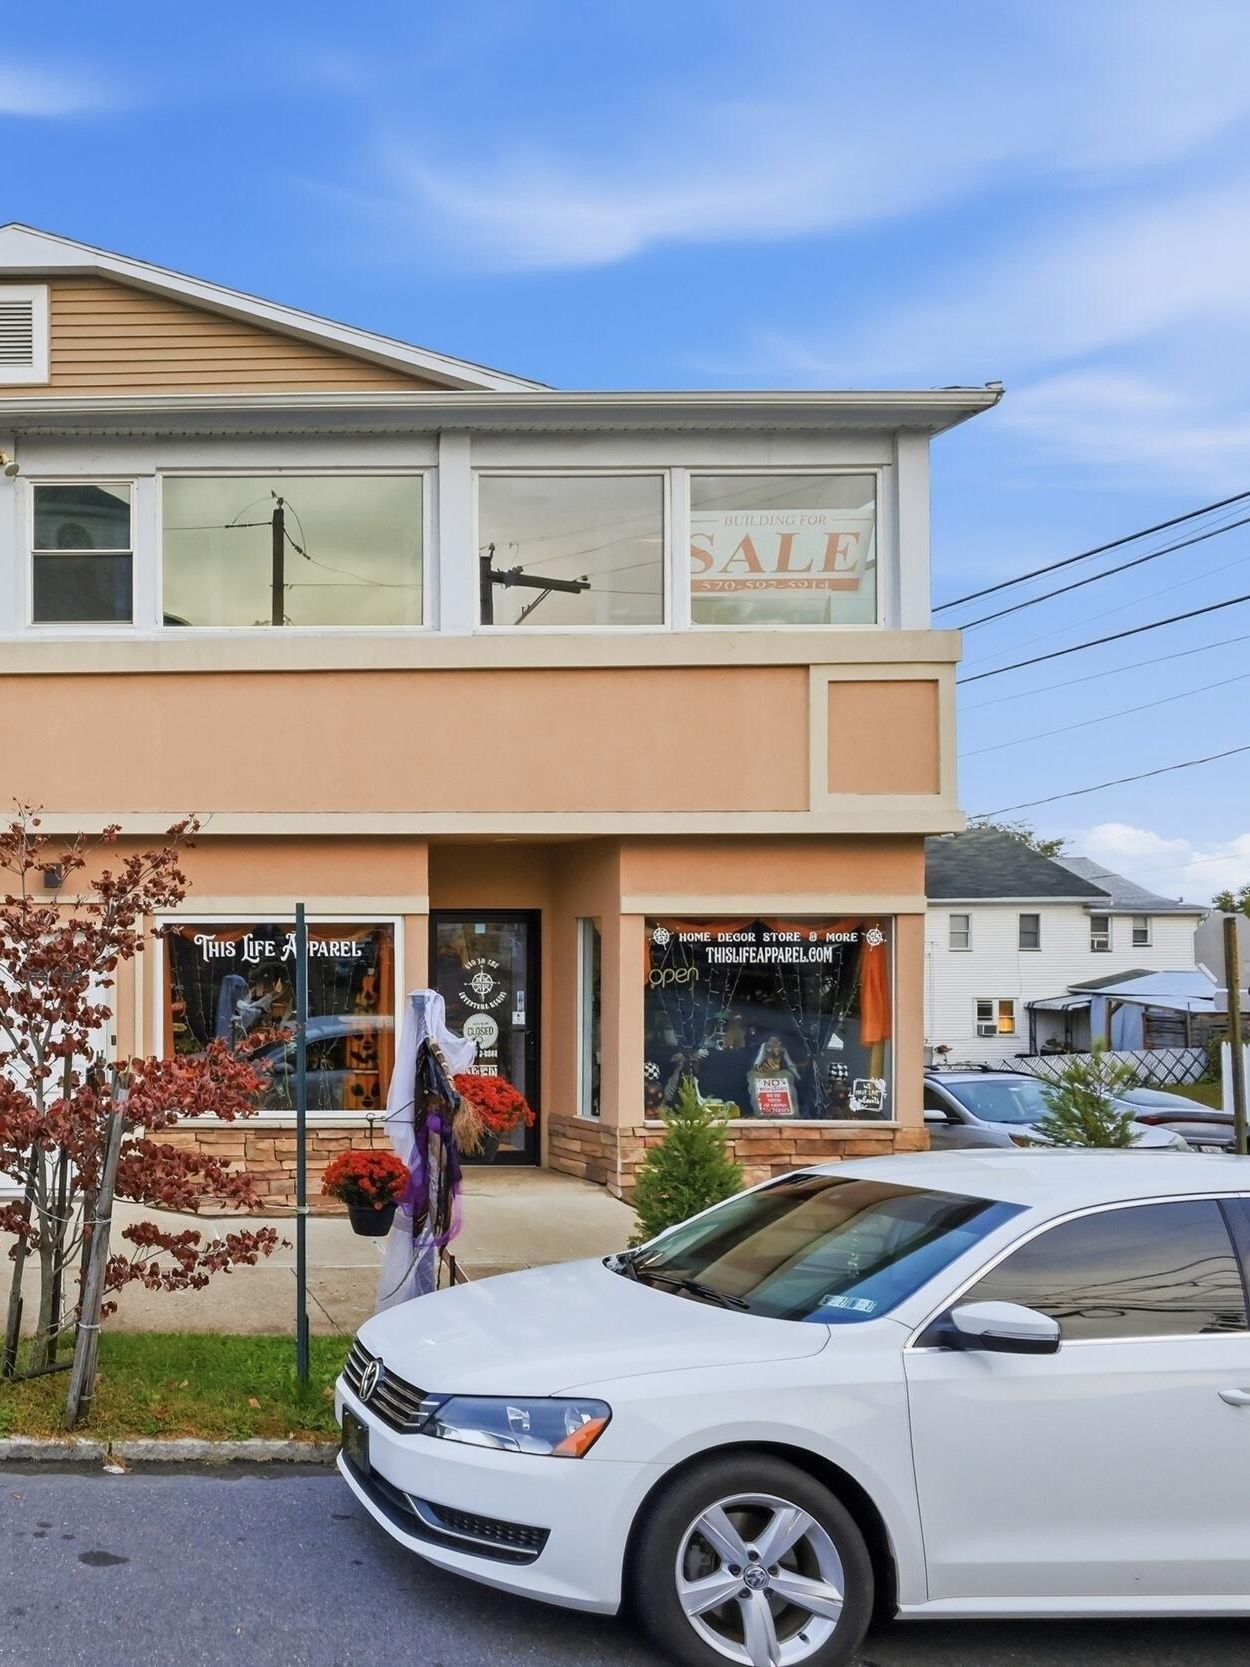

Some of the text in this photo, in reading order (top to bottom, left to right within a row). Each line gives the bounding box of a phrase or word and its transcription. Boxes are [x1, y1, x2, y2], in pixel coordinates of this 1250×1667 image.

[724, 514, 827, 526] BUILDING FOR
[690, 532, 860, 574] SALE
[679, 932, 711, 942] HOME
[717, 932, 756, 942] DECOR
[762, 932, 801, 942] STORE
[826, 932, 858, 942] MORE
[706, 947, 833, 963] THISLIFEAPPAREL.COM
[649, 967, 699, 988] open
[468, 1027, 493, 1036] CLOSED
